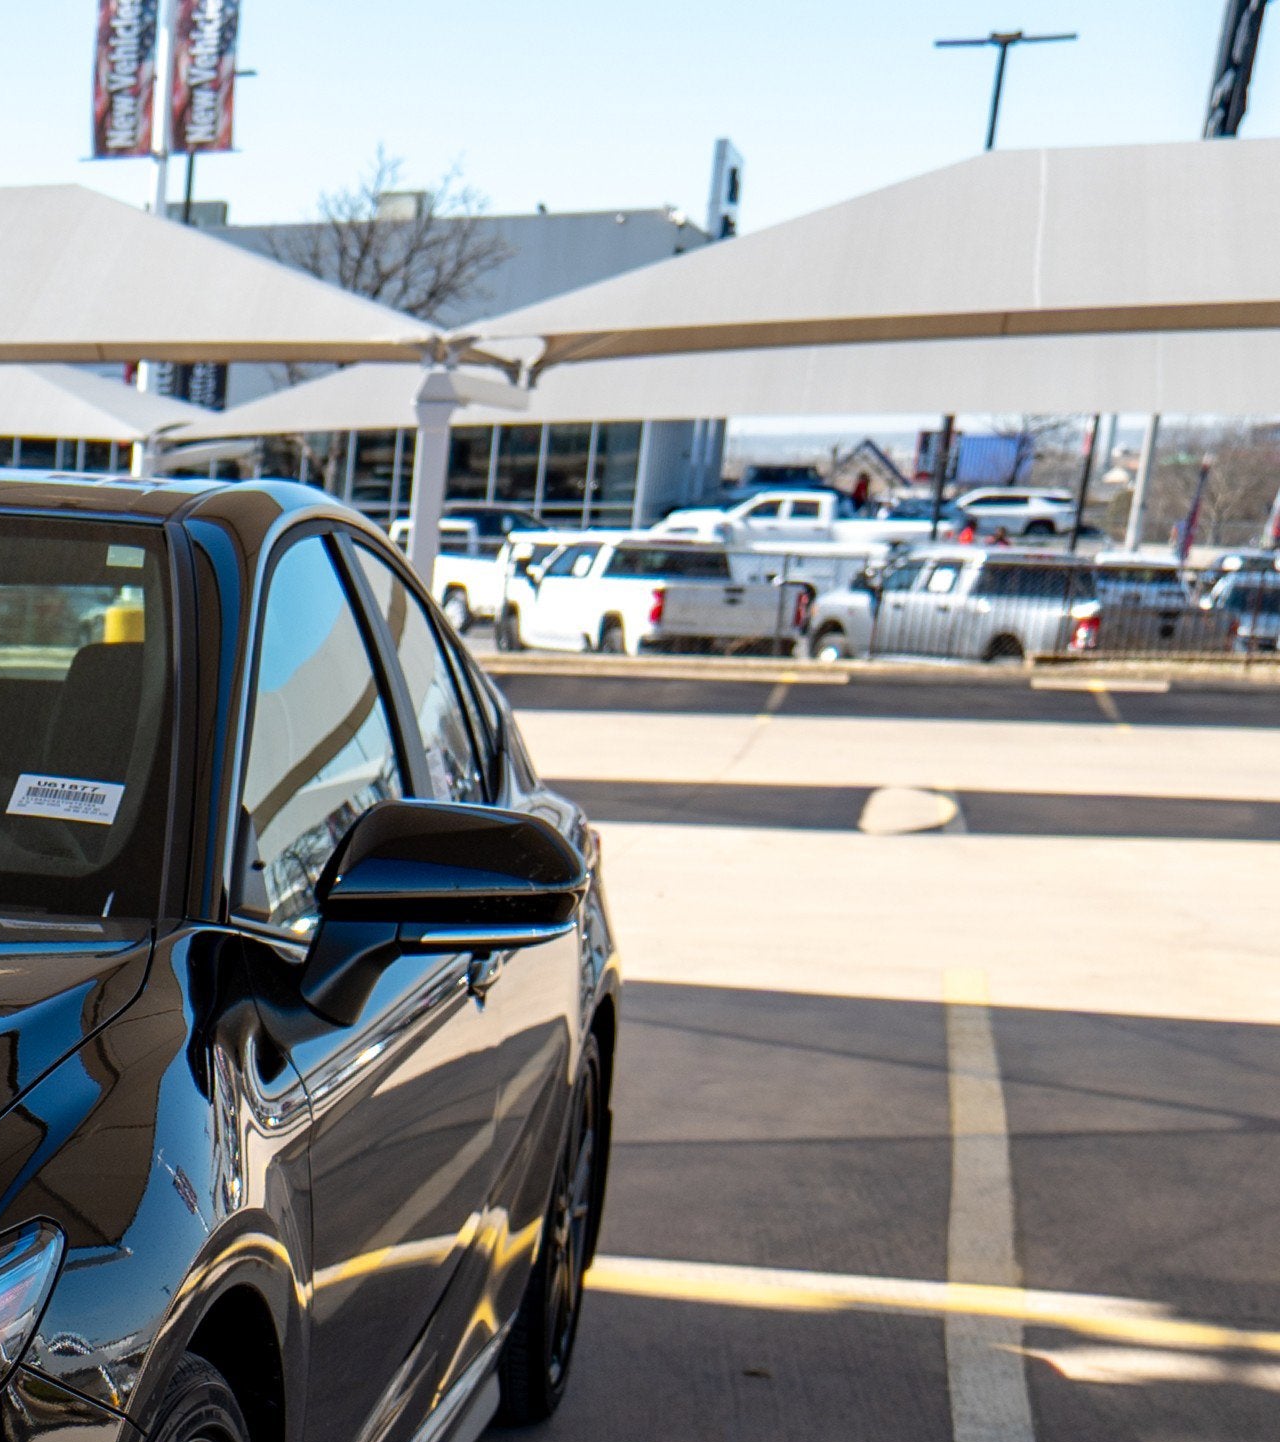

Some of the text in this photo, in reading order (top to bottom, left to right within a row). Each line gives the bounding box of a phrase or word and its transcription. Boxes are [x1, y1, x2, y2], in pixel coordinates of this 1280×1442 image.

[185, 0, 222, 143] New Vehicle
[106, 94, 137, 148] New
